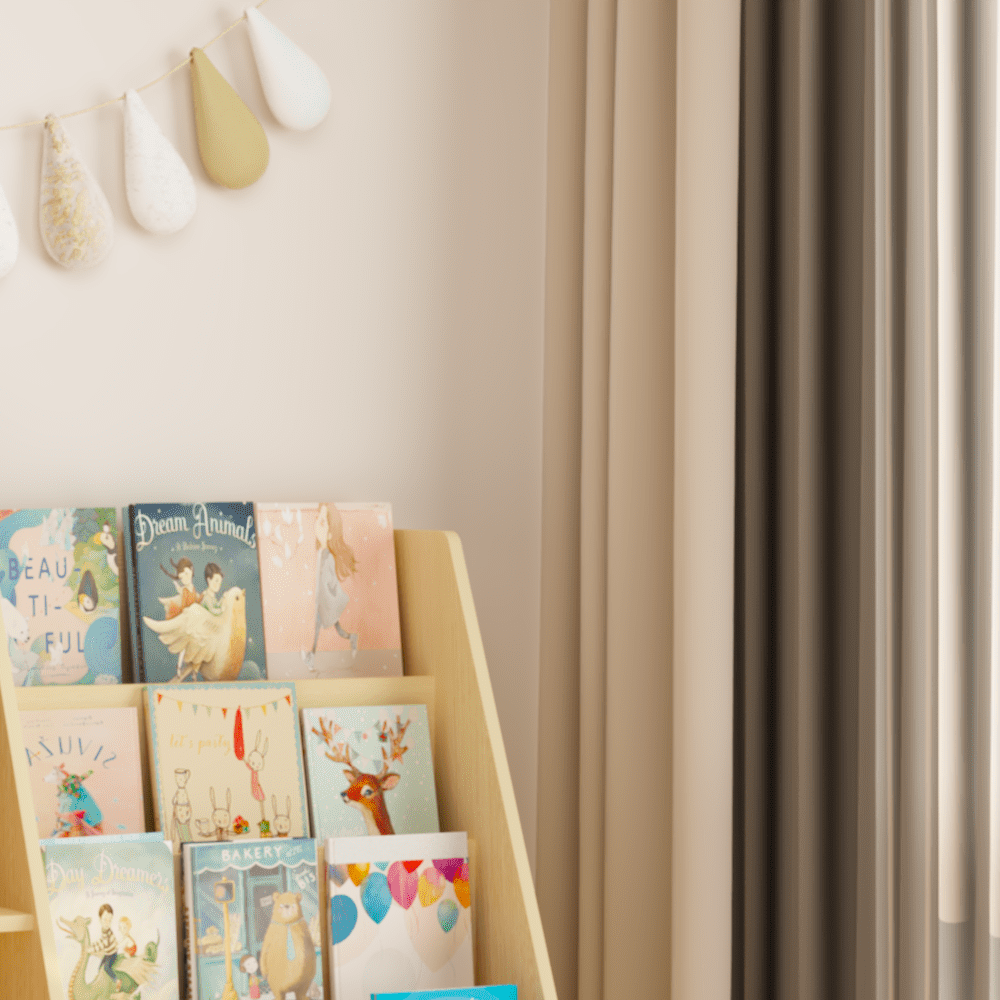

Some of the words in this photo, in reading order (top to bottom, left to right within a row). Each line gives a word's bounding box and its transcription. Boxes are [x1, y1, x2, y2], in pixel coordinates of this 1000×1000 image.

[134, 508, 190, 553] Dream
[193, 502, 257, 550] Animals
[221, 845, 283, 863] BAKERY
